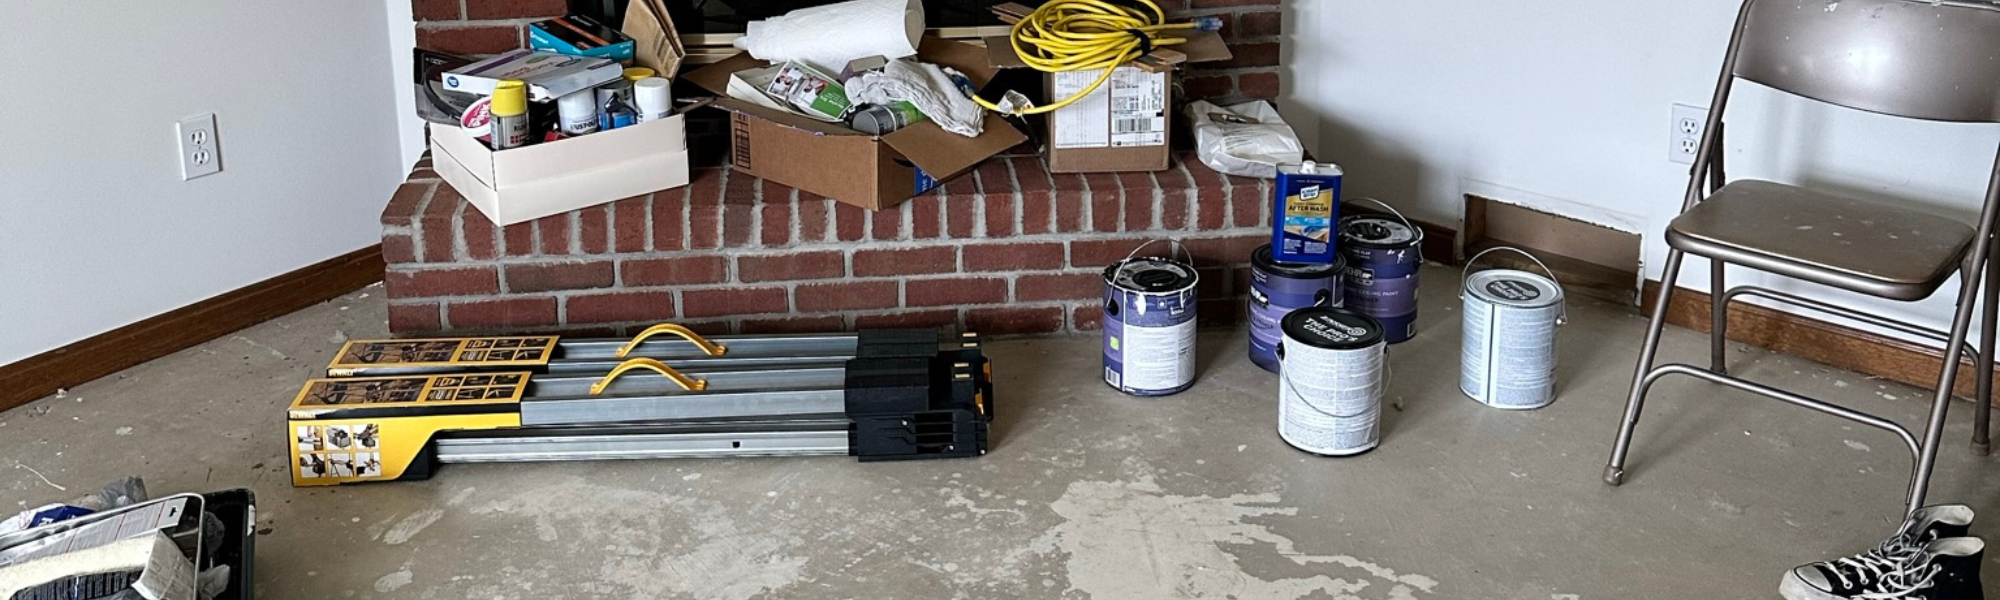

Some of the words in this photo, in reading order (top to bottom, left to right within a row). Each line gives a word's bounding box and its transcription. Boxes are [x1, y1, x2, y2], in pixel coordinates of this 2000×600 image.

[1303, 324, 1345, 343] CHOICE
[1304, 317, 1329, 330] THE
[1327, 328, 1359, 342] PRO'S
